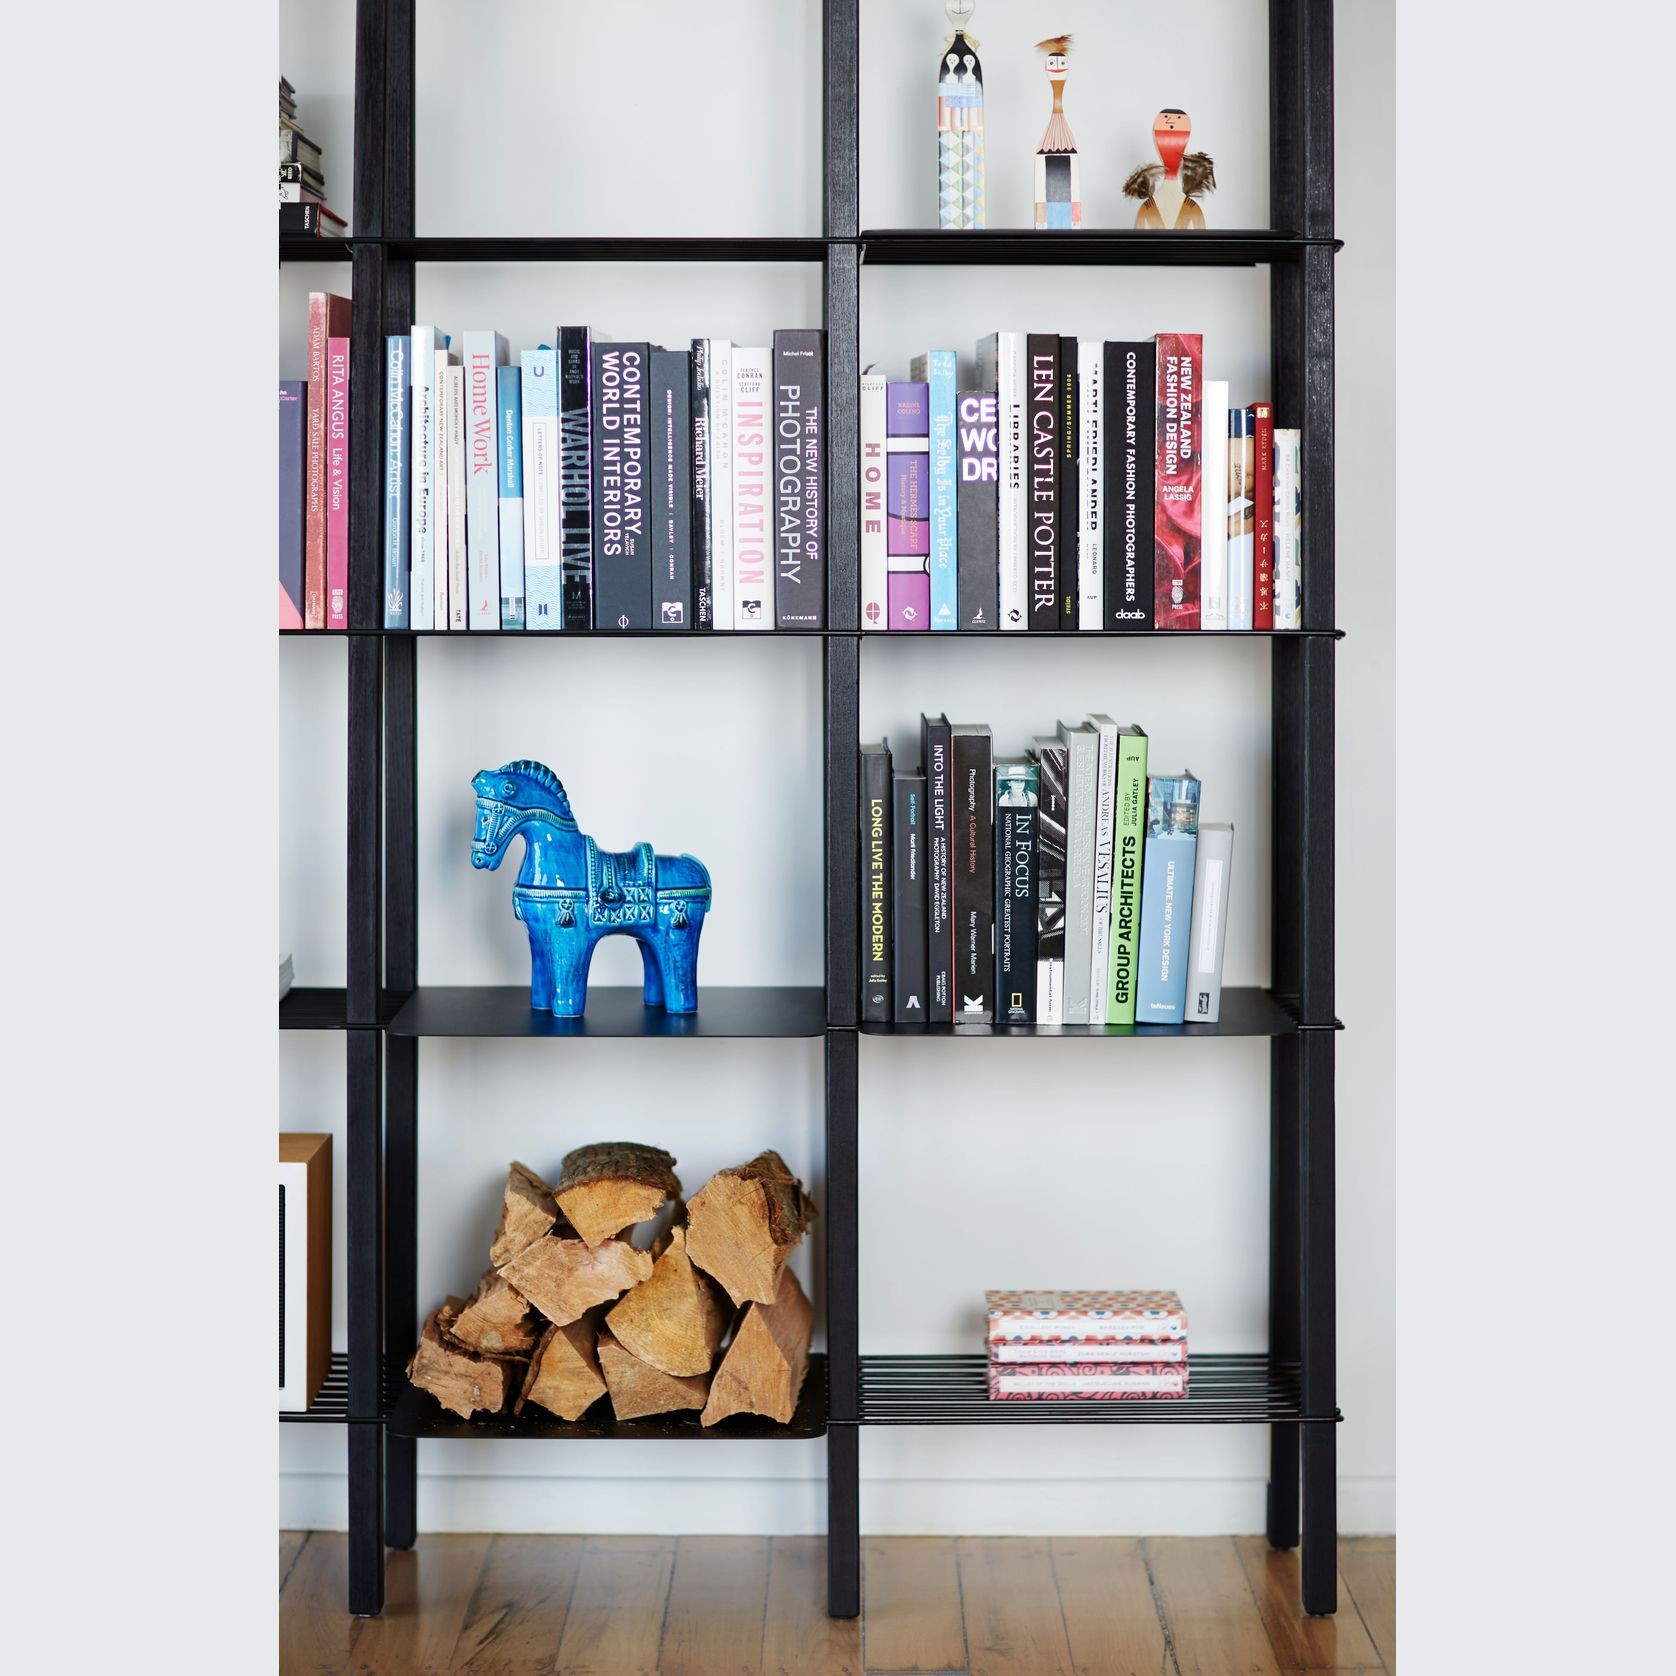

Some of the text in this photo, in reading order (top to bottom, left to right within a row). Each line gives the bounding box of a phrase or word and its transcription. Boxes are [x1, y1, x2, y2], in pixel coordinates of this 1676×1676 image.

[332, 356, 344, 439] RITA ANGUS
[390, 350, 404, 386] Colin
[696, 346, 705, 365] Philip
[312, 408, 320, 431] YARD
[623, 352, 641, 534] CONTEMPORARY
[1166, 357, 1177, 474] FASHION DESIGN
[1180, 357, 1191, 458] NEW ZEALAND
[332, 479, 342, 510] Vision
[333, 448, 342, 467] Life
[390, 459, 403, 497] Artist
[417, 386, 429, 534] Architecture in Europe
[538, 452, 543, 460] OF
[561, 408, 589, 519] WARHOL
[603, 352, 621, 555] WORLD INTERIORS
[695, 417, 706, 500] Richard Meier
[738, 401, 764, 584] INSPIRATION
[780, 385, 801, 583] PHOTOGRAPHY
[805, 407, 817, 559] THE NEW HISTORY OF
[866, 443, 881, 533] HOME
[934, 411, 953, 569] The Selby Is in Your Place
[1034, 355, 1054, 611] LEN CASTLE POTTER
[1126, 352, 1136, 601] CONTEMPORARY FASHION PHOTOGRAPHERS
[910, 481, 919, 519] HERMÈS
[562, 528, 590, 585] LIVE
[1116, 609, 1145, 619] daab
[934, 745, 944, 830] INTO THE LIGHT
[968, 769, 976, 810] Photography
[1101, 788, 1110, 836] ANDREAS
[871, 800, 883, 961] LONG LIVE THE MODERN
[969, 850, 977, 873] History
[1015, 814, 1031, 897] IN FOCUS
[1096, 840, 1111, 914] VESALIUS
[1116, 836, 1135, 1003] GROUP ARCHITECTS
[1160, 861, 1174, 981] ULTIMATE NEW YORK DESIGN
